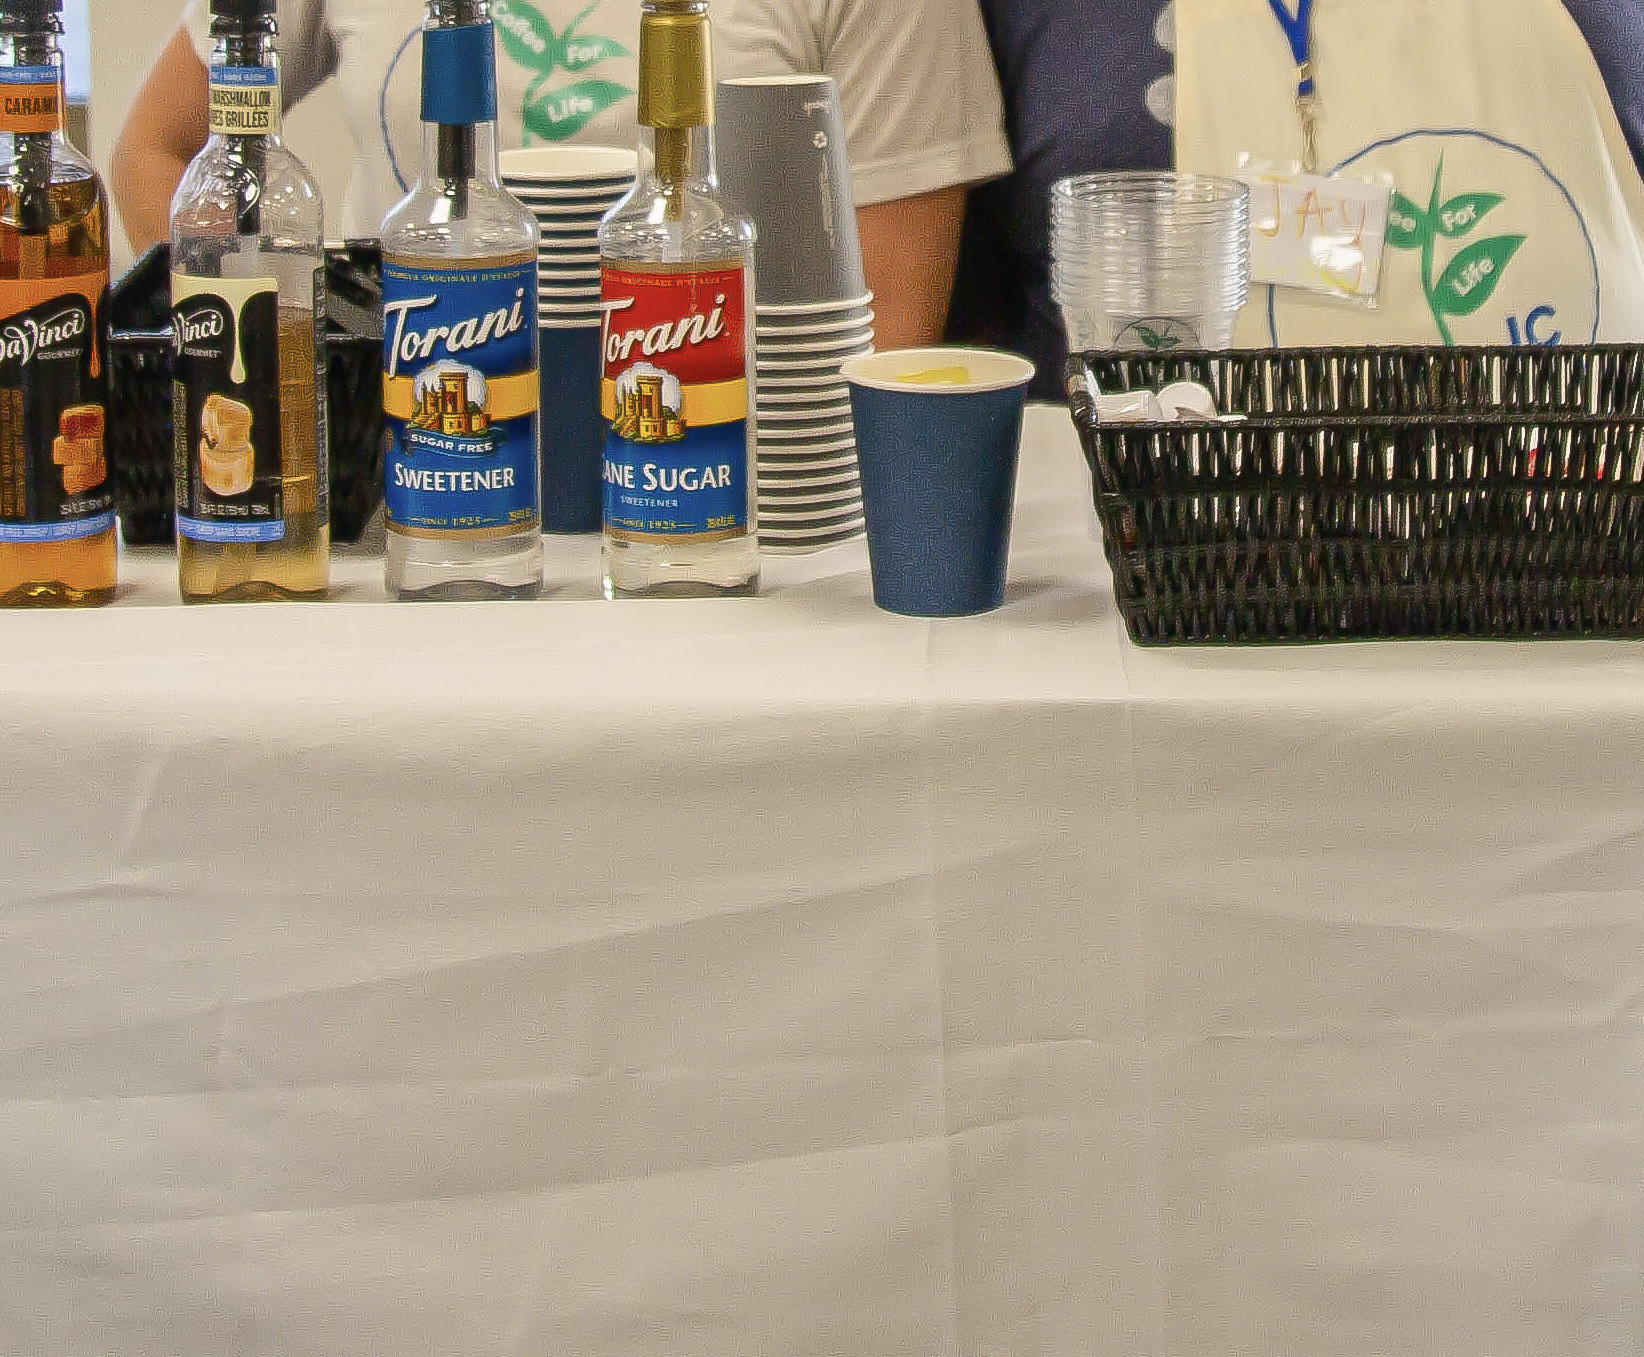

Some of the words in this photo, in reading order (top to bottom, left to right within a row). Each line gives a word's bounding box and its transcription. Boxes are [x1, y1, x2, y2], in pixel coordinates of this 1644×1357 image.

[490, 0, 545, 54] Coffee
[566, 44, 603, 63] For
[547, 97, 593, 123] Life
[1441, 202, 1477, 232] For
[1451, 255, 1495, 297] Life
[384, 287, 525, 380] Torani
[601, 293, 726, 379] Torani
[411, 433, 455, 452] SUGAR
[457, 441, 493, 453] FREE
[393, 463, 515, 492] SWEETENER
[602, 459, 635, 489] ANE
[642, 463, 732, 492] SUGAR
